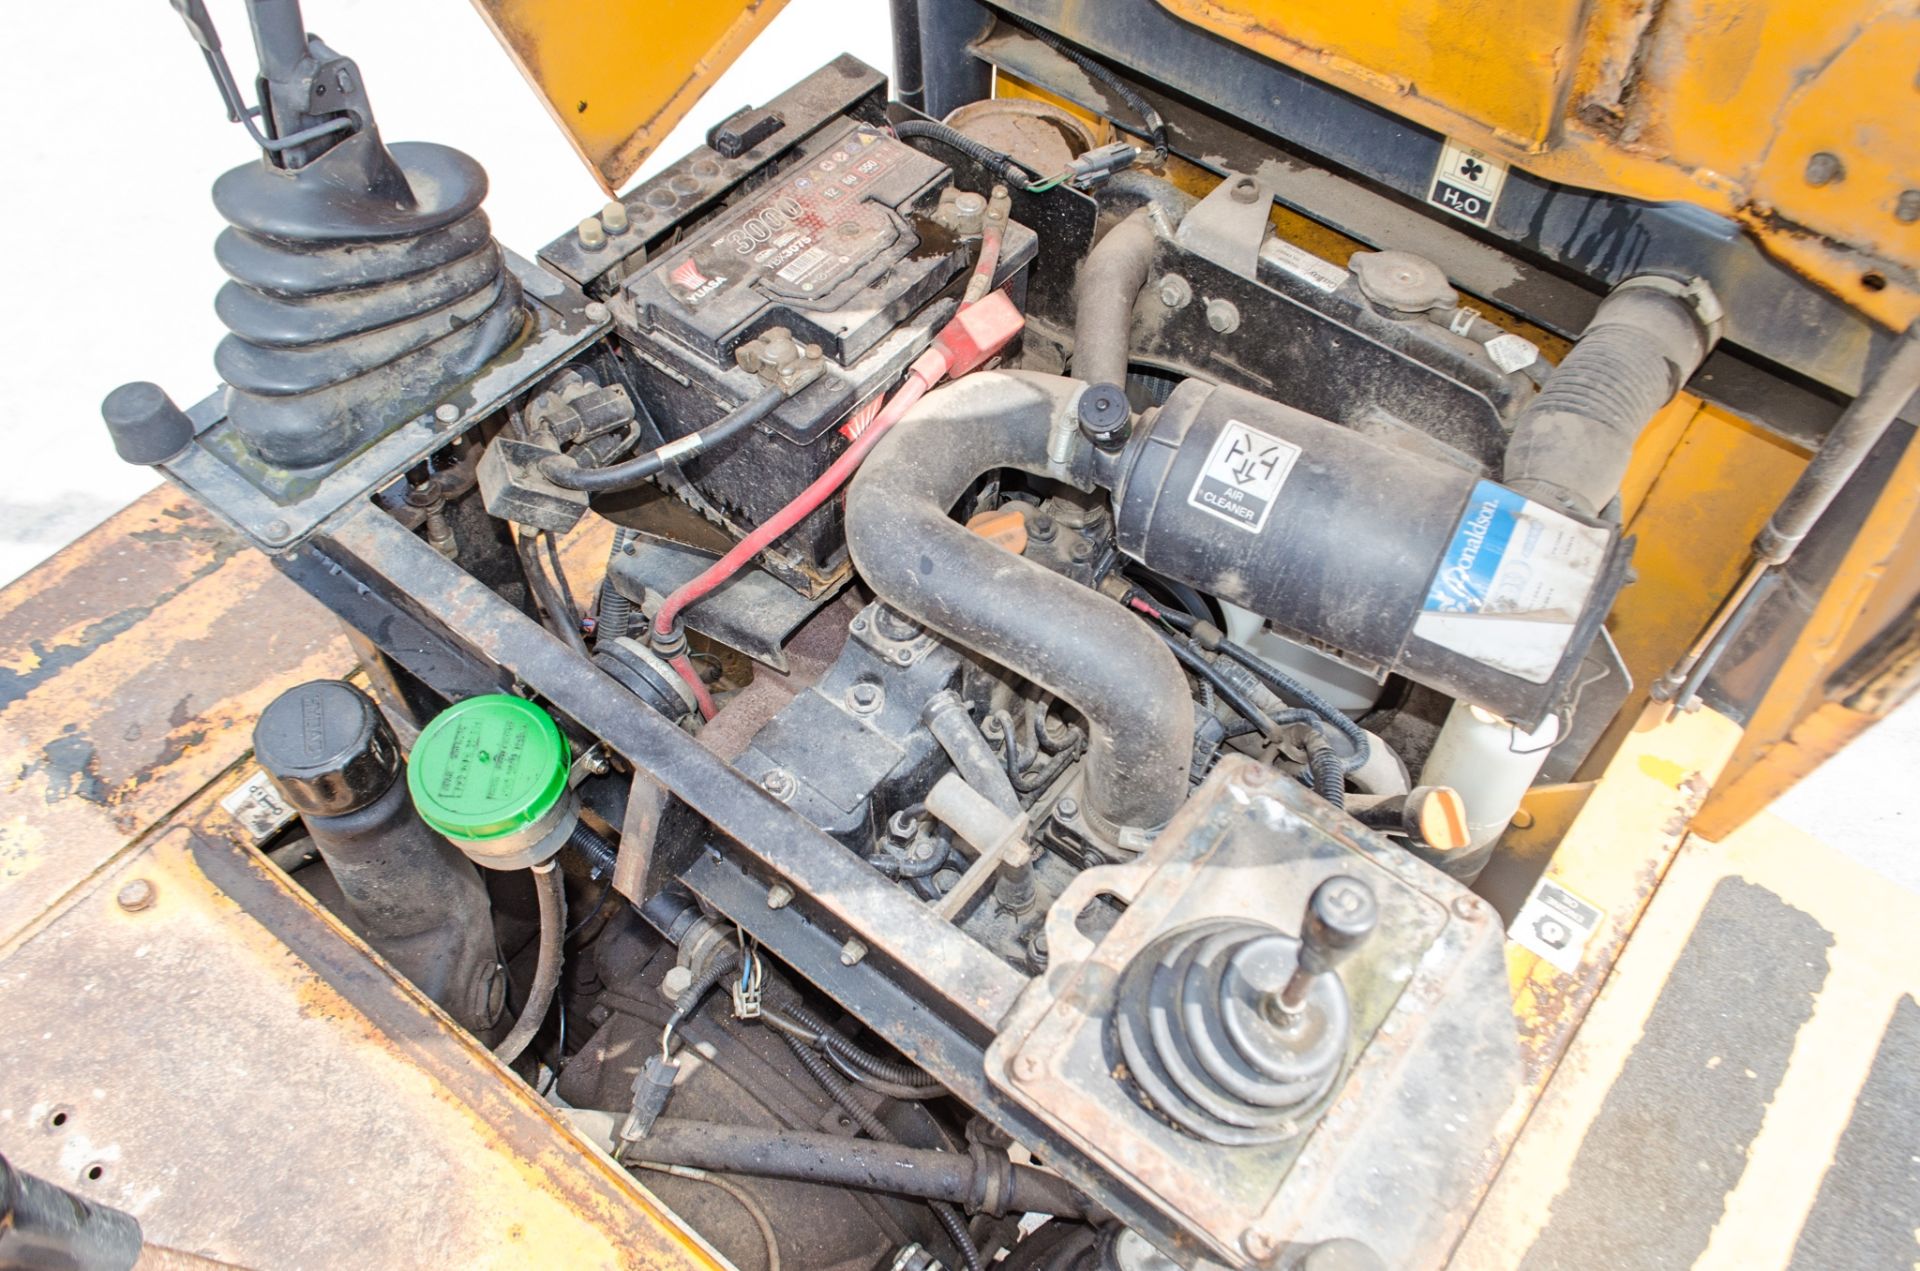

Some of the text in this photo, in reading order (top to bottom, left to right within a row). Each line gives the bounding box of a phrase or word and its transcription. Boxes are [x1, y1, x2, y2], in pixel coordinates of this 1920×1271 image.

[824, 188, 839, 198] 12
[727, 197, 804, 254] 3000
[686, 276, 728, 302] YUASA
[1203, 492, 1255, 520] CLEANER
[1224, 487, 1244, 502] AIR
